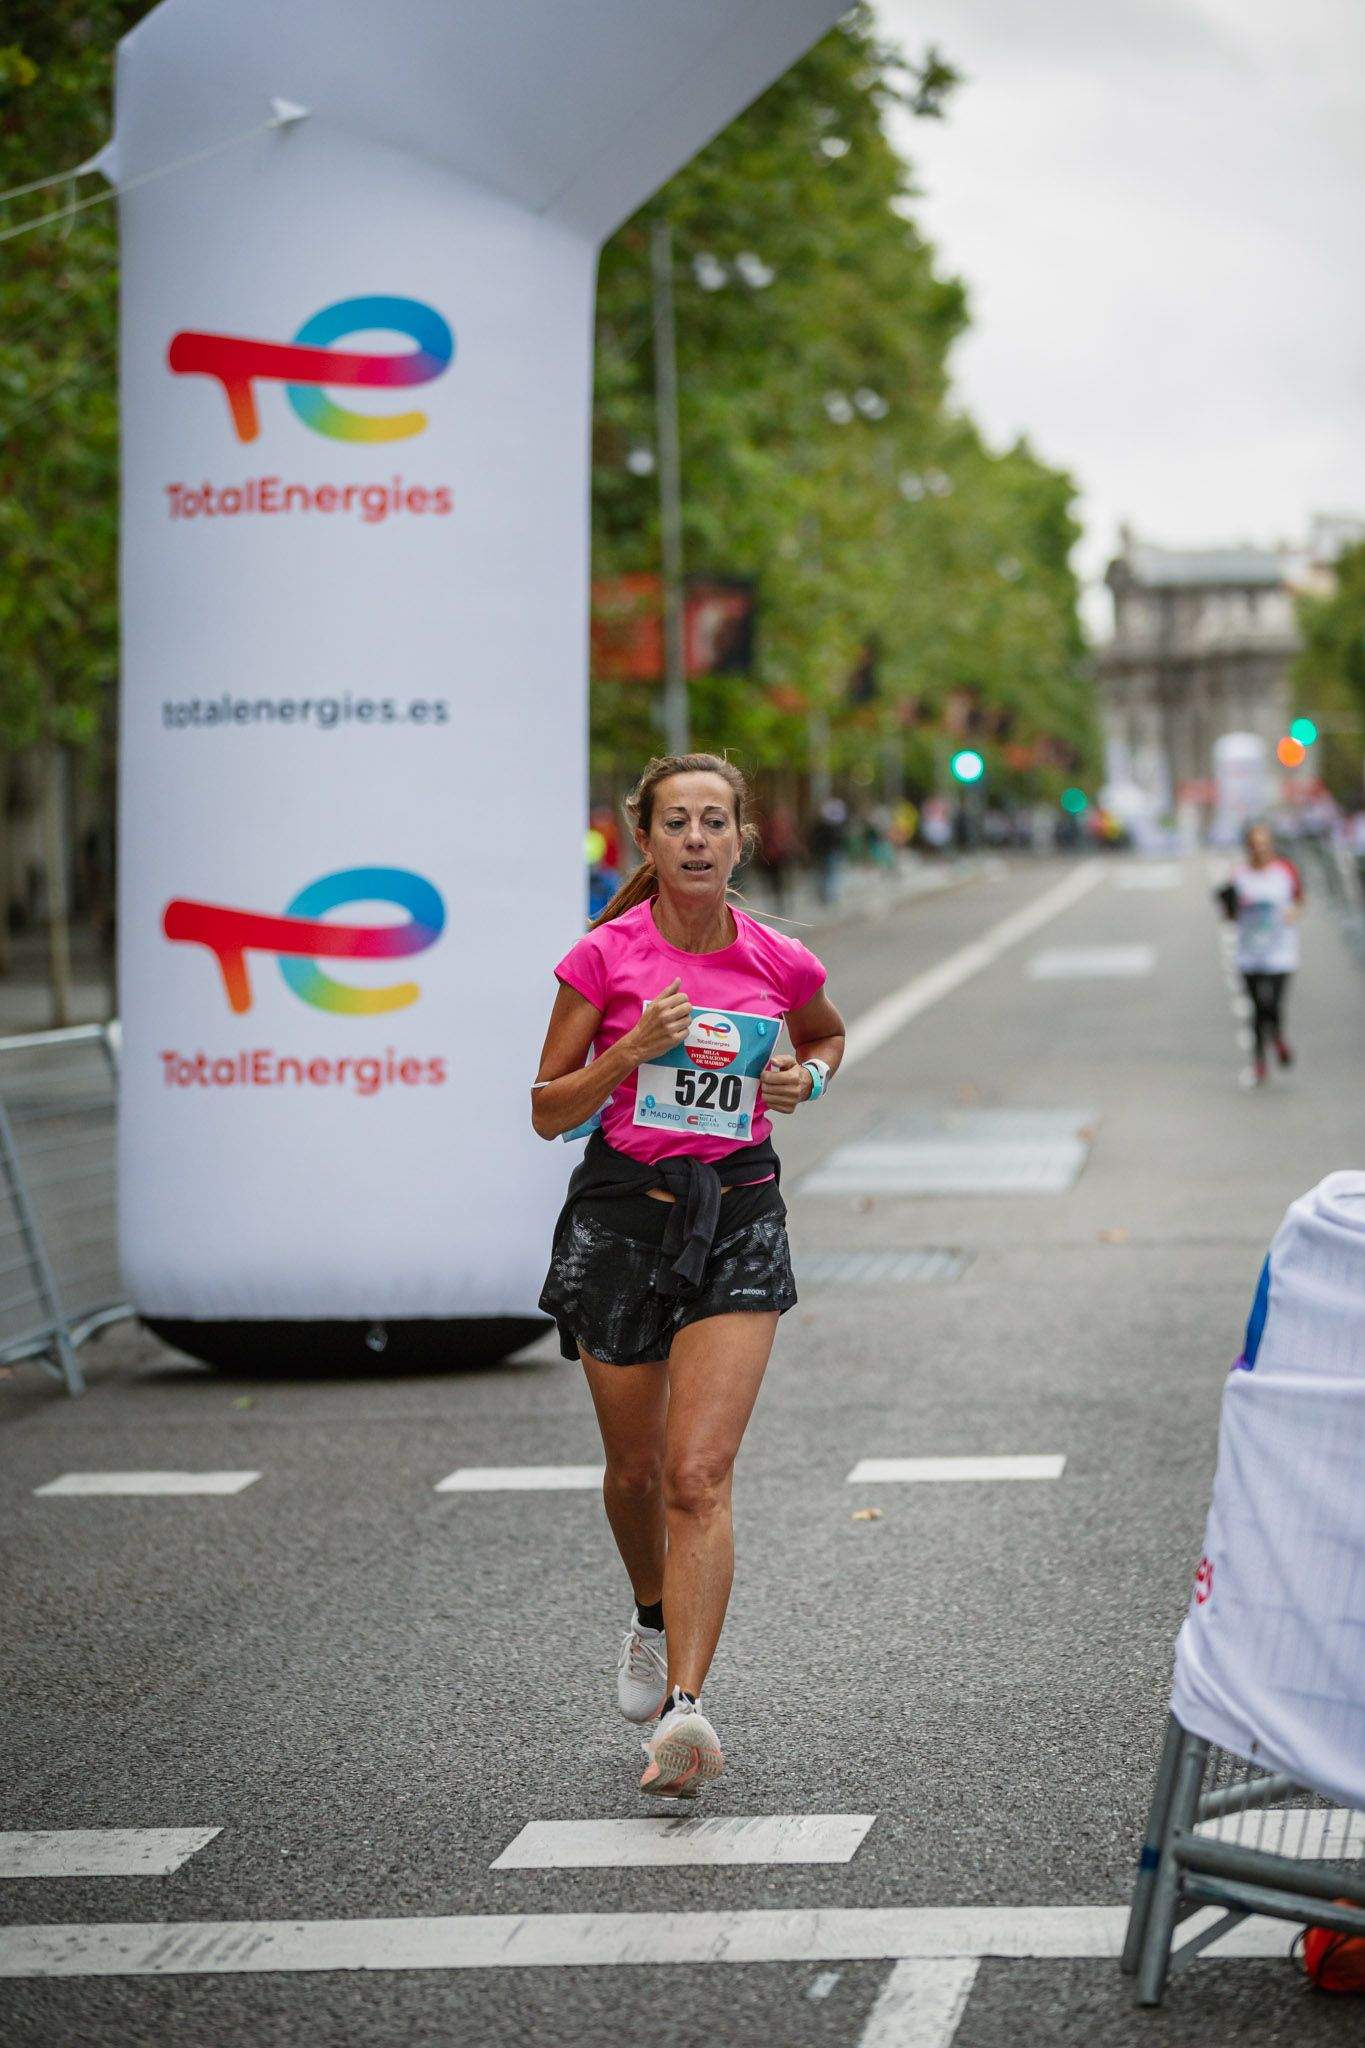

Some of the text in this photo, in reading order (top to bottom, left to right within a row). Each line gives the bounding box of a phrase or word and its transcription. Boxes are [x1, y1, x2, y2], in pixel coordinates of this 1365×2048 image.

[165, 475, 455, 523] TotalEnergies
[162, 693, 450, 729] totalenergies.es
[159, 1046, 447, 1096] TotalEnergies
[675, 1069, 742, 1113] 520
[650, 1110, 681, 1121] MADRID
